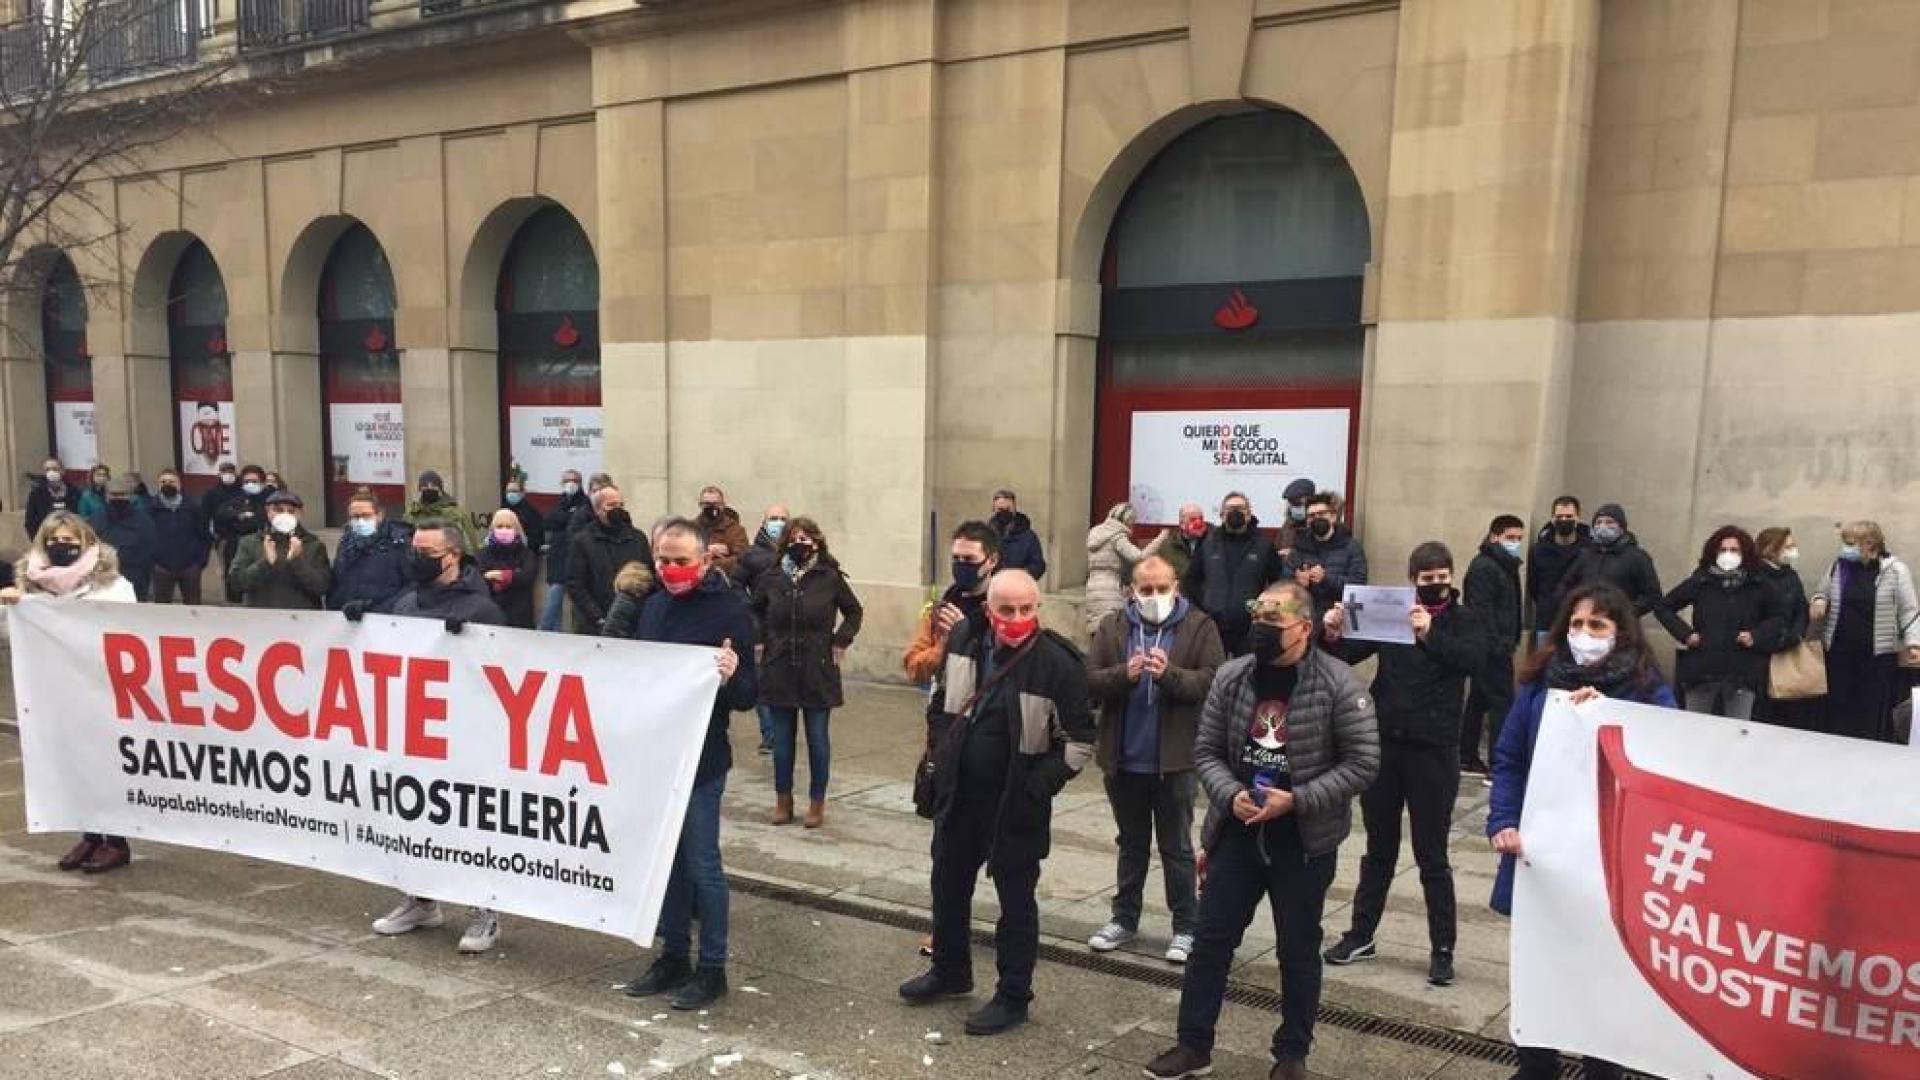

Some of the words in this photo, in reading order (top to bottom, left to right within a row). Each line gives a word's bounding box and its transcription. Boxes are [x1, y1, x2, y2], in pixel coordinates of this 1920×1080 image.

[1183, 424, 1230, 438] QUIERO
[1233, 424, 1260, 438] QUE
[1202, 438, 1218, 451] MI
[1221, 438, 1279, 451] NEGOCIO
[1213, 451, 1237, 465] SEA
[1240, 451, 1288, 465] DIGITAL
[103, 631, 450, 760] RESCATE
[482, 664, 608, 786] YA
[119, 735, 311, 797] SALVEMOS
[323, 759, 361, 808] LA
[370, 768, 611, 854] HOSTELERÍA
[127, 788, 338, 837] #AupaLaHosteleriaNavarra
[356, 824, 614, 892] #AupaNafarroakoOstalaritza
[1644, 823, 1713, 893] #
[1650, 936, 1920, 1050] HOSTELER
